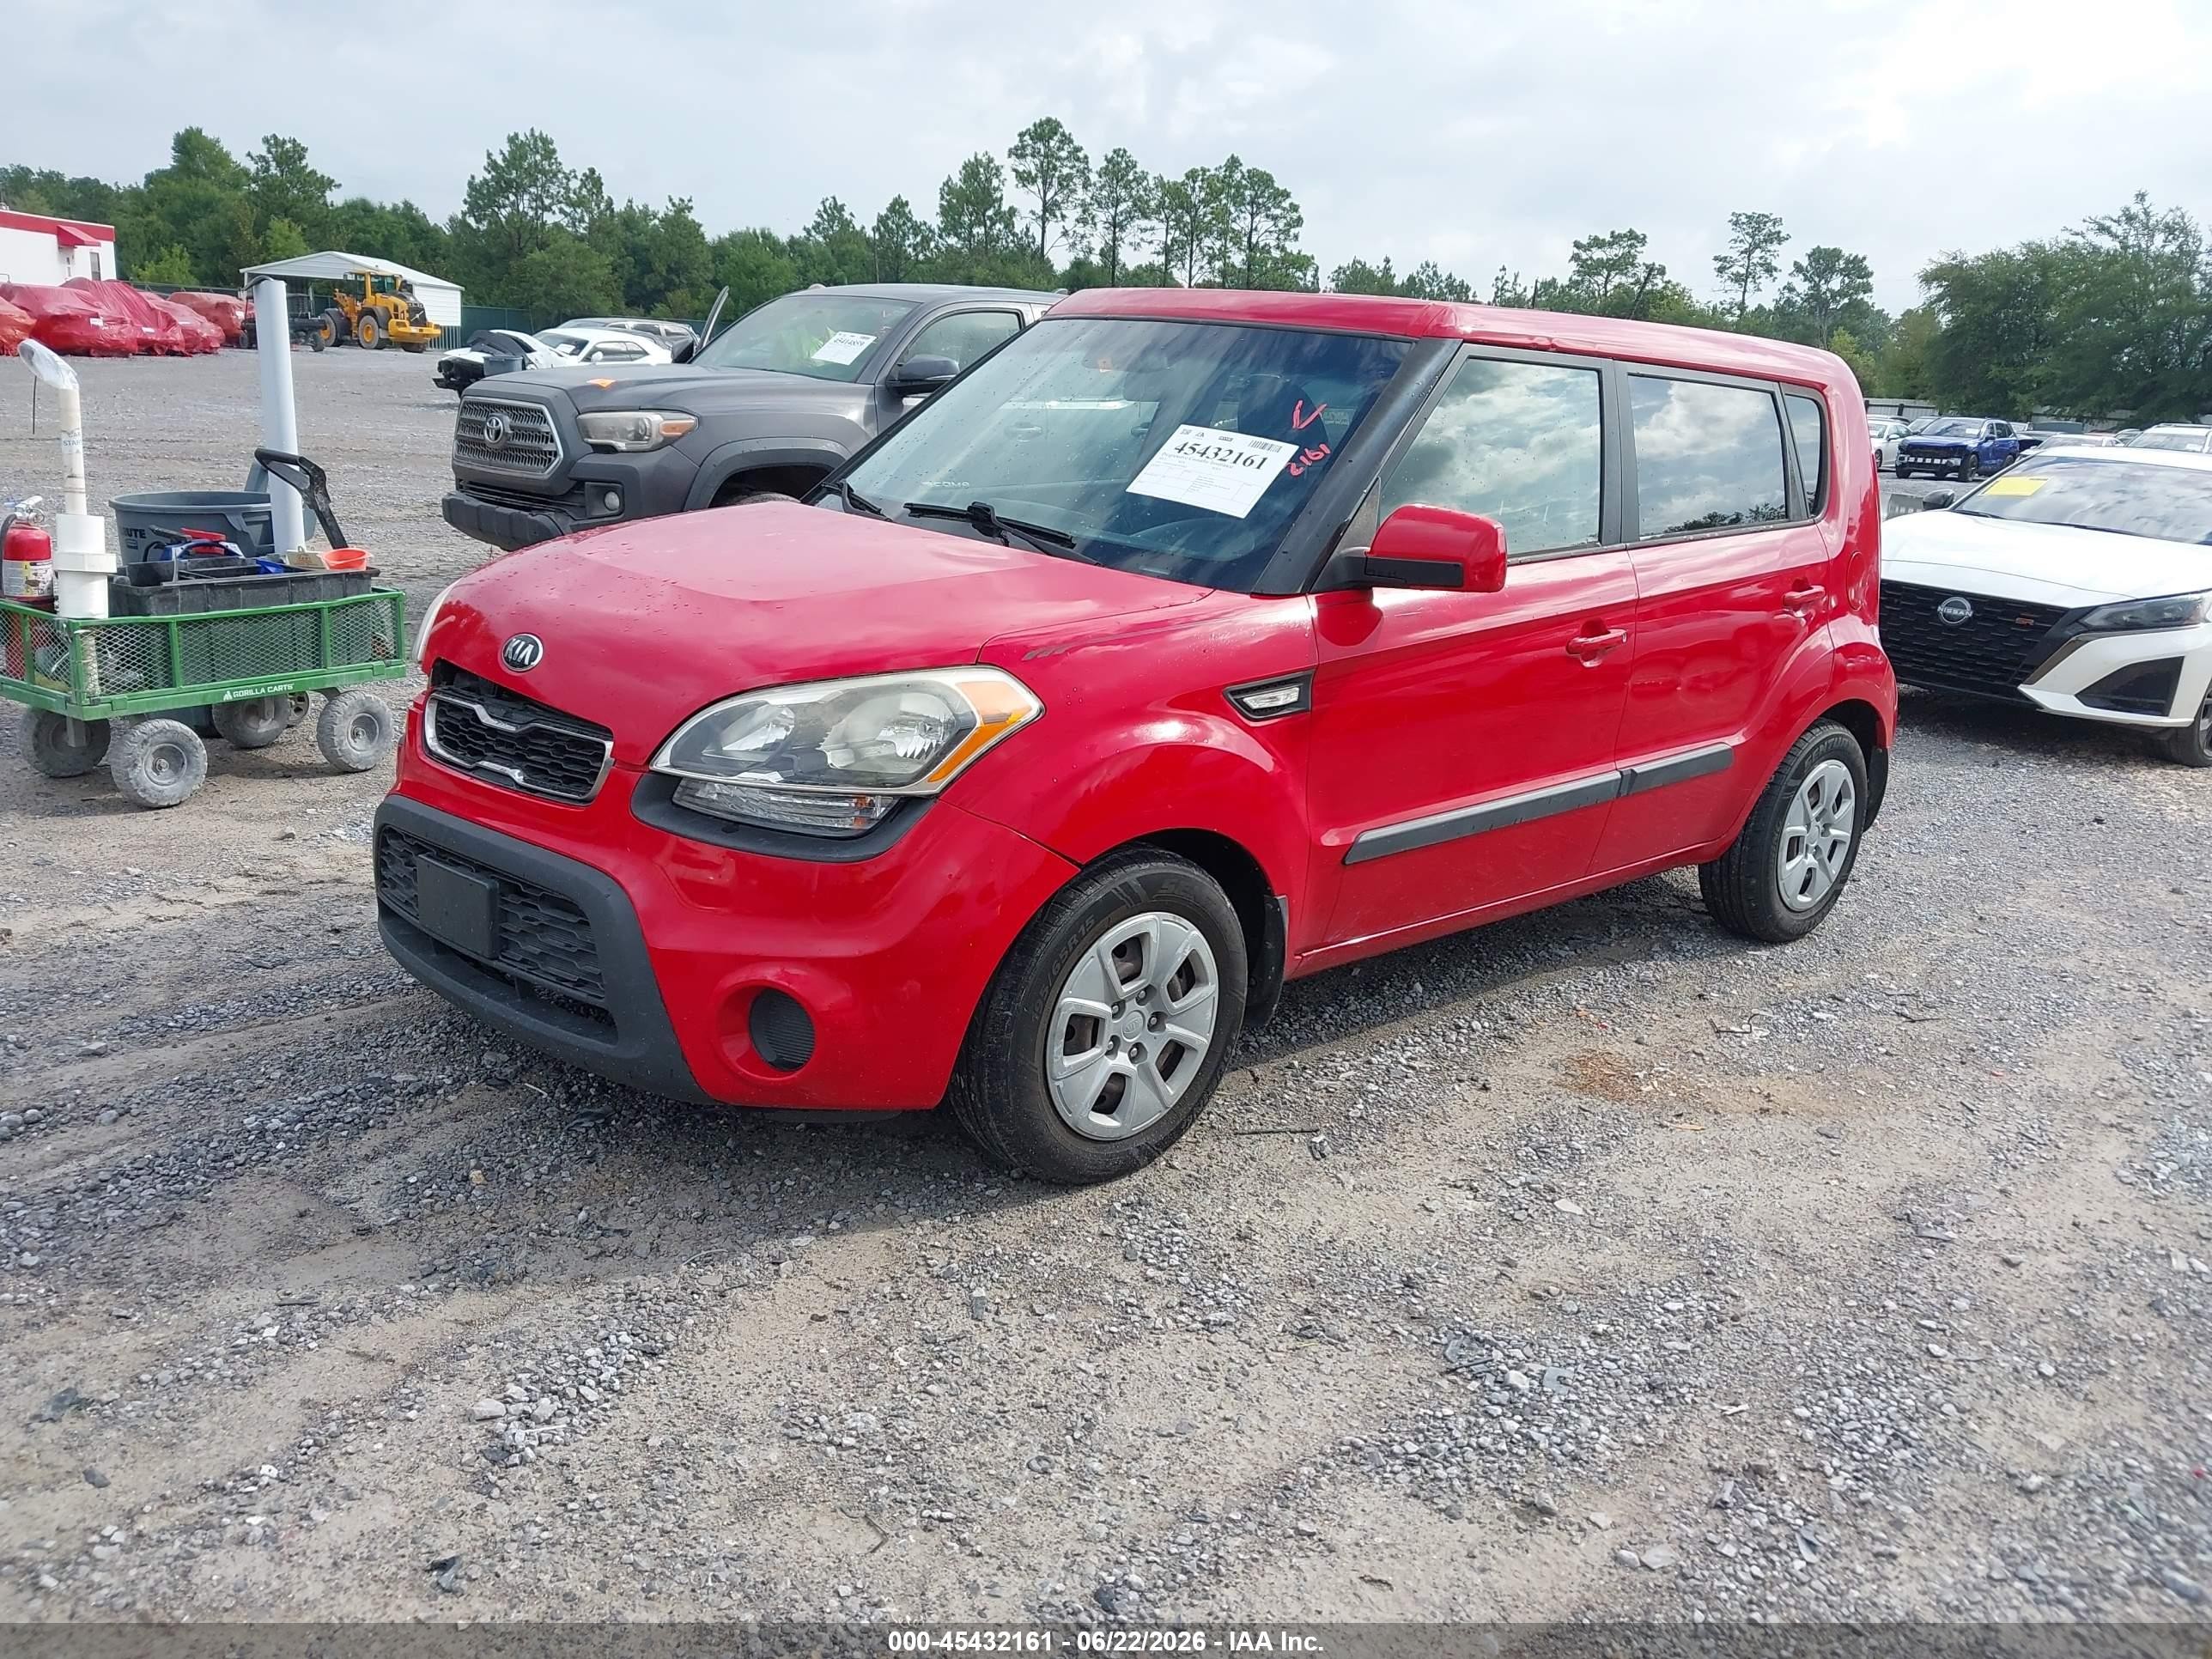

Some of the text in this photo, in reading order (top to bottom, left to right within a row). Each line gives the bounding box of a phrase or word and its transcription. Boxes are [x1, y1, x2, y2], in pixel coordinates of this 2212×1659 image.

[1173, 441, 1268, 471] 45432161
[1937, 606, 1973, 617] NISSAN
[504, 638, 534, 665] KIA
[233, 684, 294, 698] GORILLA CARTS
